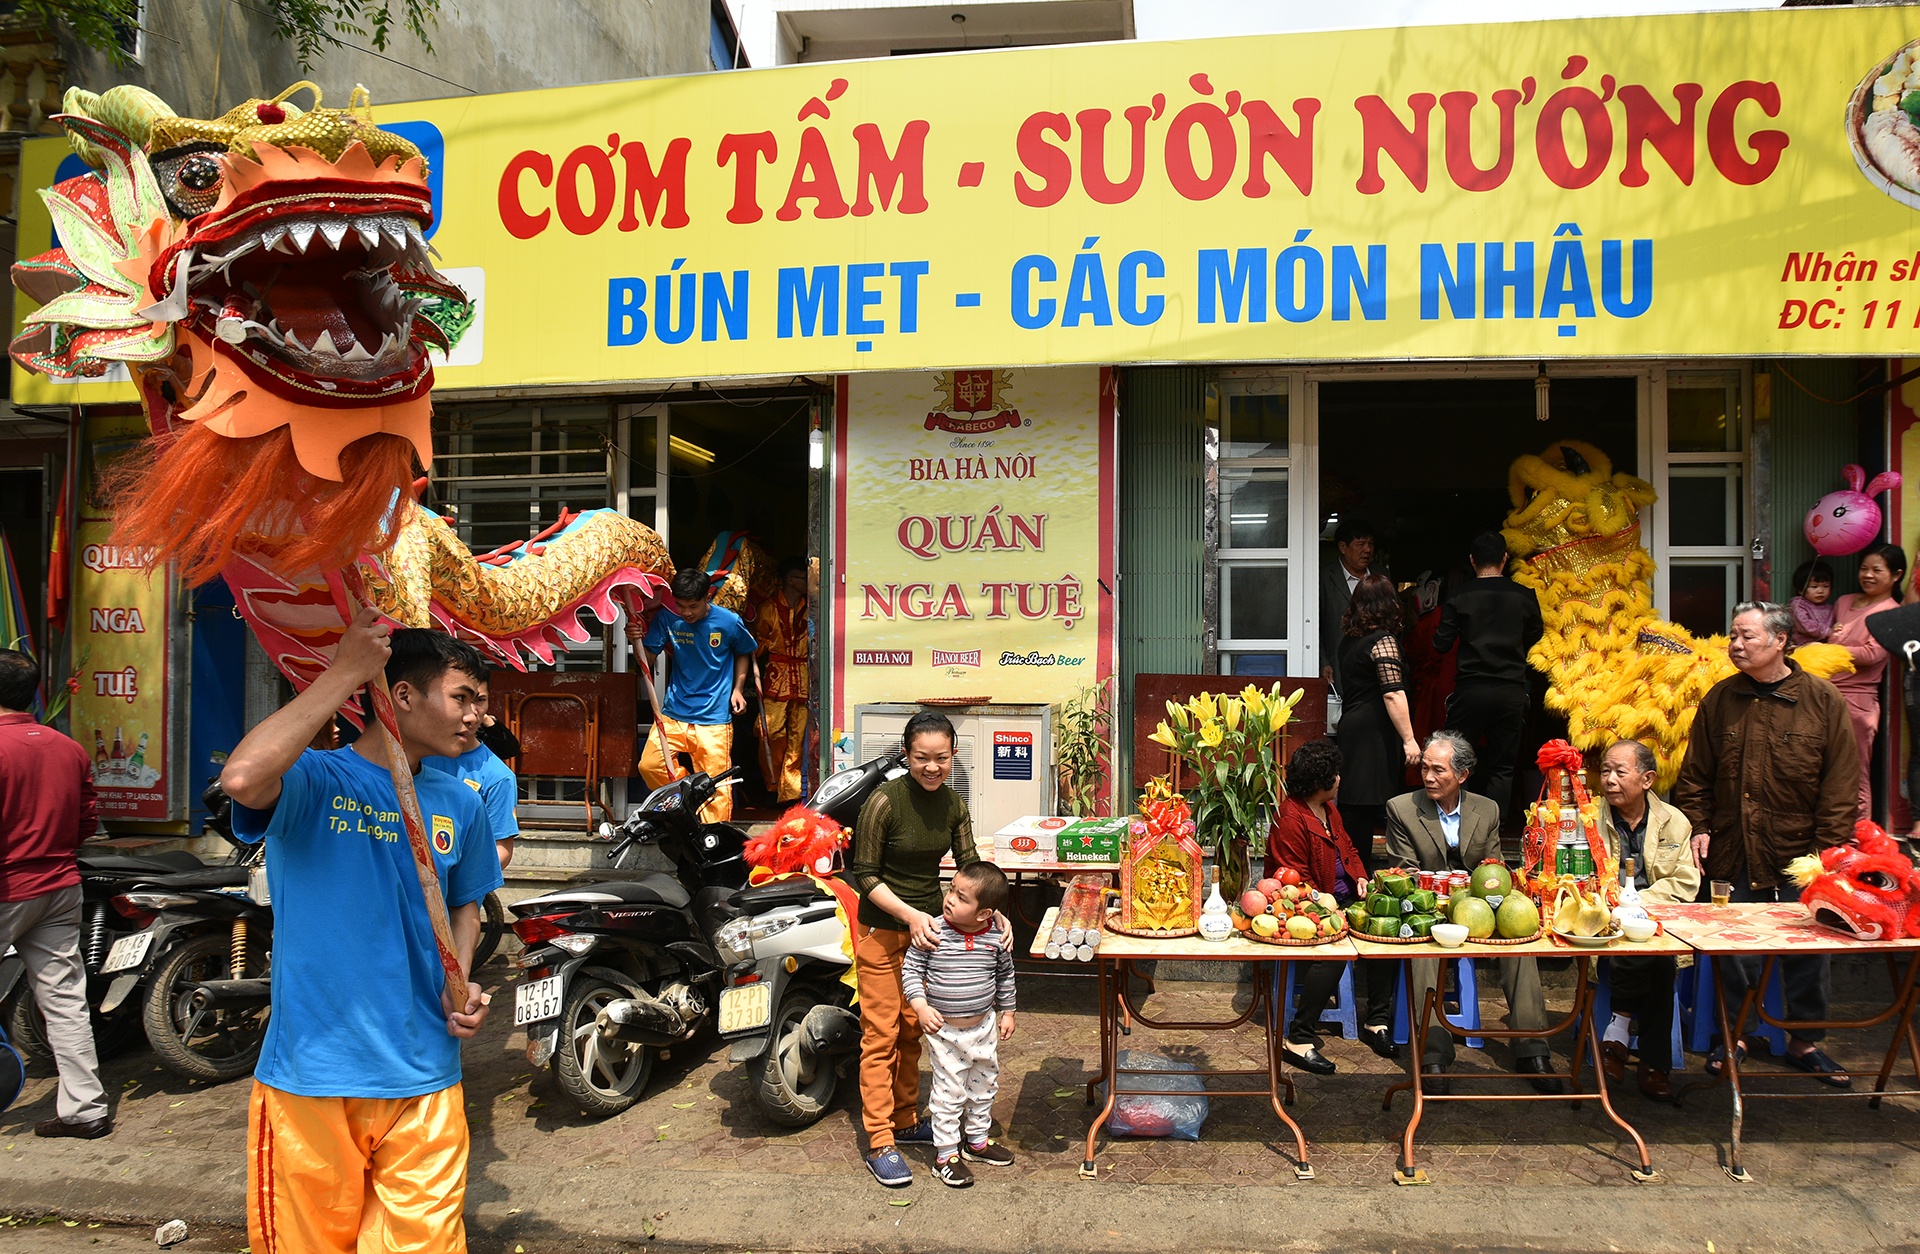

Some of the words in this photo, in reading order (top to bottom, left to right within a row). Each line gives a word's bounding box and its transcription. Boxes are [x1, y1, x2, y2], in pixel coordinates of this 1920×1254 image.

[498, 132, 692, 239] CƠM
[716, 78, 930, 224] TẤM
[1013, 72, 1322, 208] SƯỜN
[1354, 54, 1790, 196] NƯỚNG
[1780, 251, 1878, 292] Nhận
[607, 257, 749, 347] BÚN
[776, 260, 929, 352] MẸT
[1010, 235, 1165, 330] CÁC
[1197, 228, 1388, 324] MÓN
[1419, 222, 1654, 337] NHẬU
[1777, 298, 1846, 329] ĐC:
[1863, 300, 1902, 329] 11
[949, 436, 976, 449] Since
[908, 457, 950, 481] BIA
[954, 453, 989, 480] HÀ
[994, 451, 1037, 482] NỘI
[897, 504, 1047, 559] QUÁN
[861, 583, 971, 620] NGA
[982, 574, 1083, 628] TUỆ
[91, 608, 144, 632] NGA
[855, 652, 874, 663] BIA
[874, 650, 891, 663] HÀ
[891, 650, 910, 664] NỘI
[933, 651, 959, 665] HANOI
[960, 651, 979, 665] BEER
[1057, 655, 1086, 666] Beer
[94, 666, 138, 703] TUỆ
[995, 734, 1029, 743] Shinco
[997, 746, 1028, 758] 新科
[329, 816, 352, 834] Tp.
[1017, 838, 1030, 847] 333
[1066, 851, 1110, 861] Heineken
[602, 910, 657, 920] VISION
[524, 979, 554, 1002] 12-P1
[728, 986, 763, 1009] 12-P1
[517, 996, 559, 1023] 083.67
[726, 1005, 763, 1029] 3730
